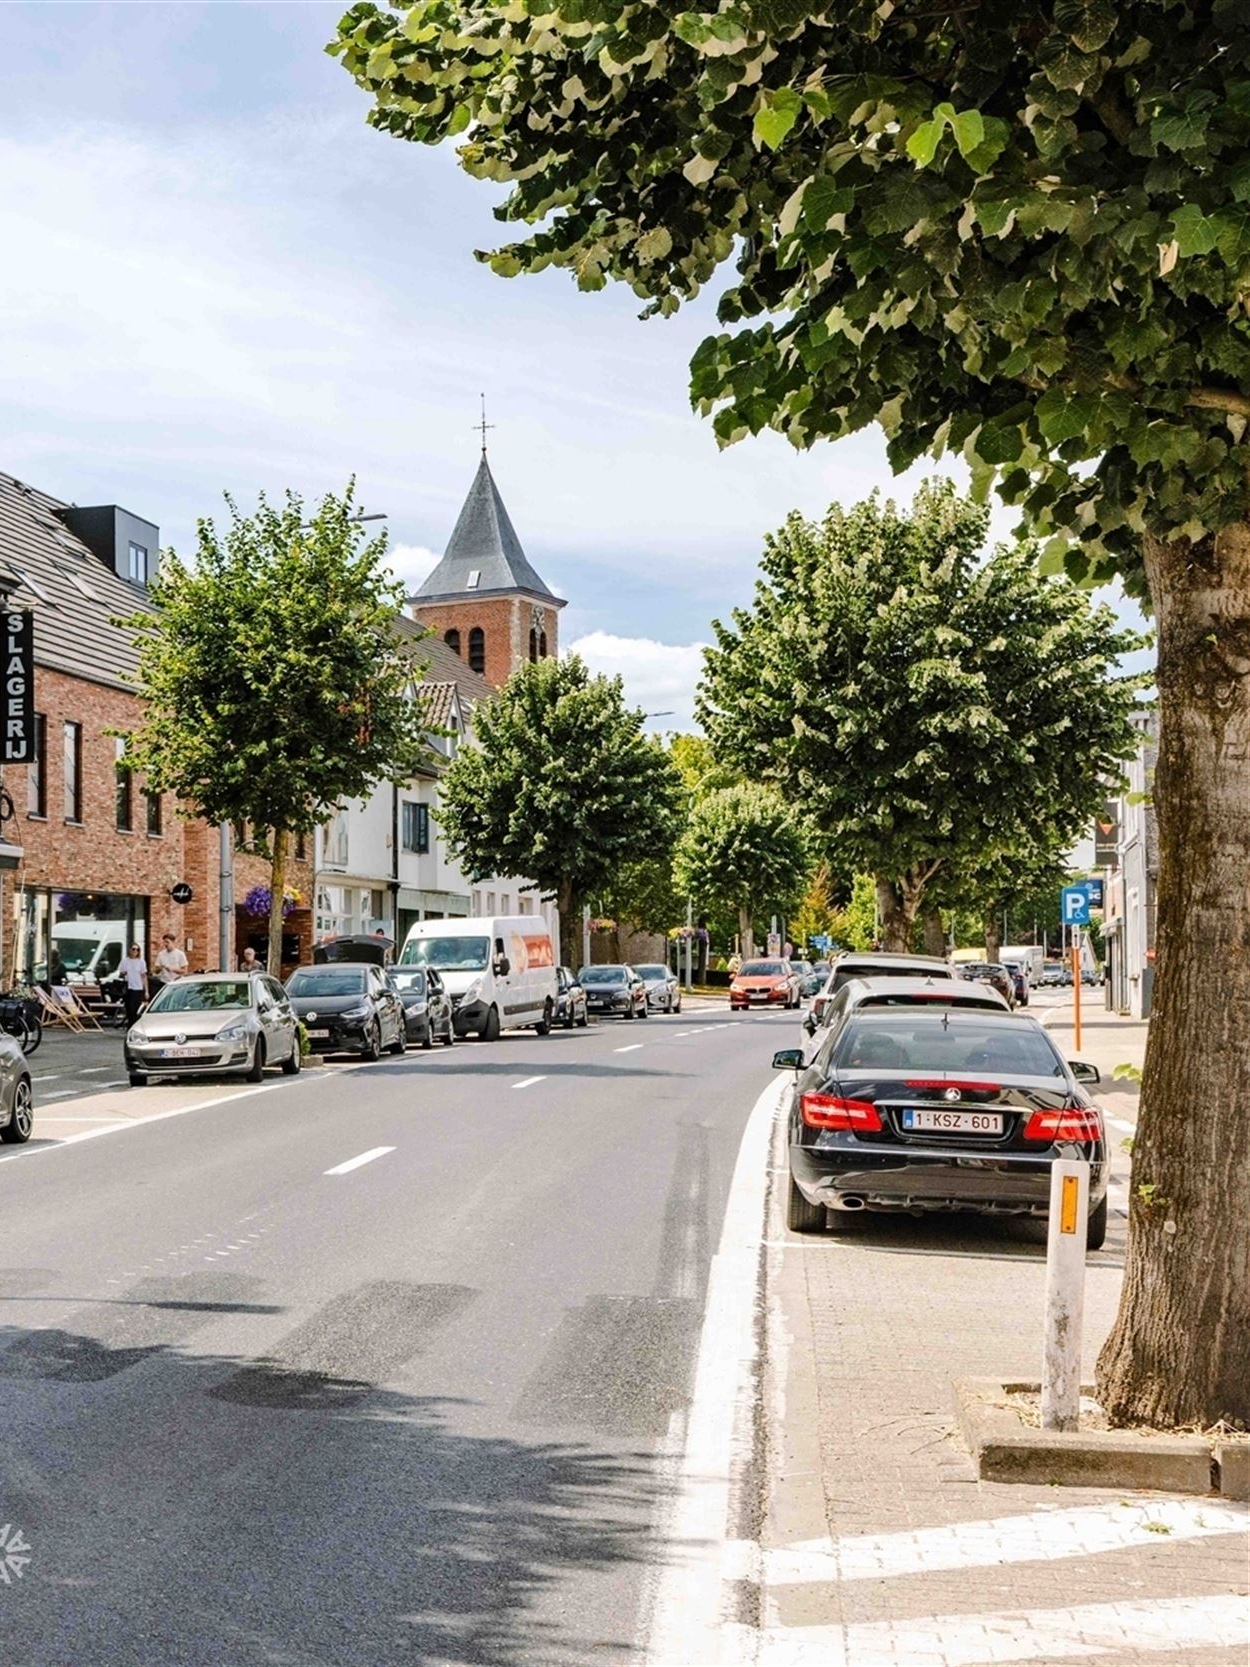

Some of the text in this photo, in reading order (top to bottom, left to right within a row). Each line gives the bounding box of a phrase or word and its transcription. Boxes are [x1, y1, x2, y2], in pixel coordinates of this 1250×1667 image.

[6, 614, 27, 760] SLAGERIJ
[1066, 893, 1085, 919] P
[916, 1113, 999, 1130] 1-KSZ-601
